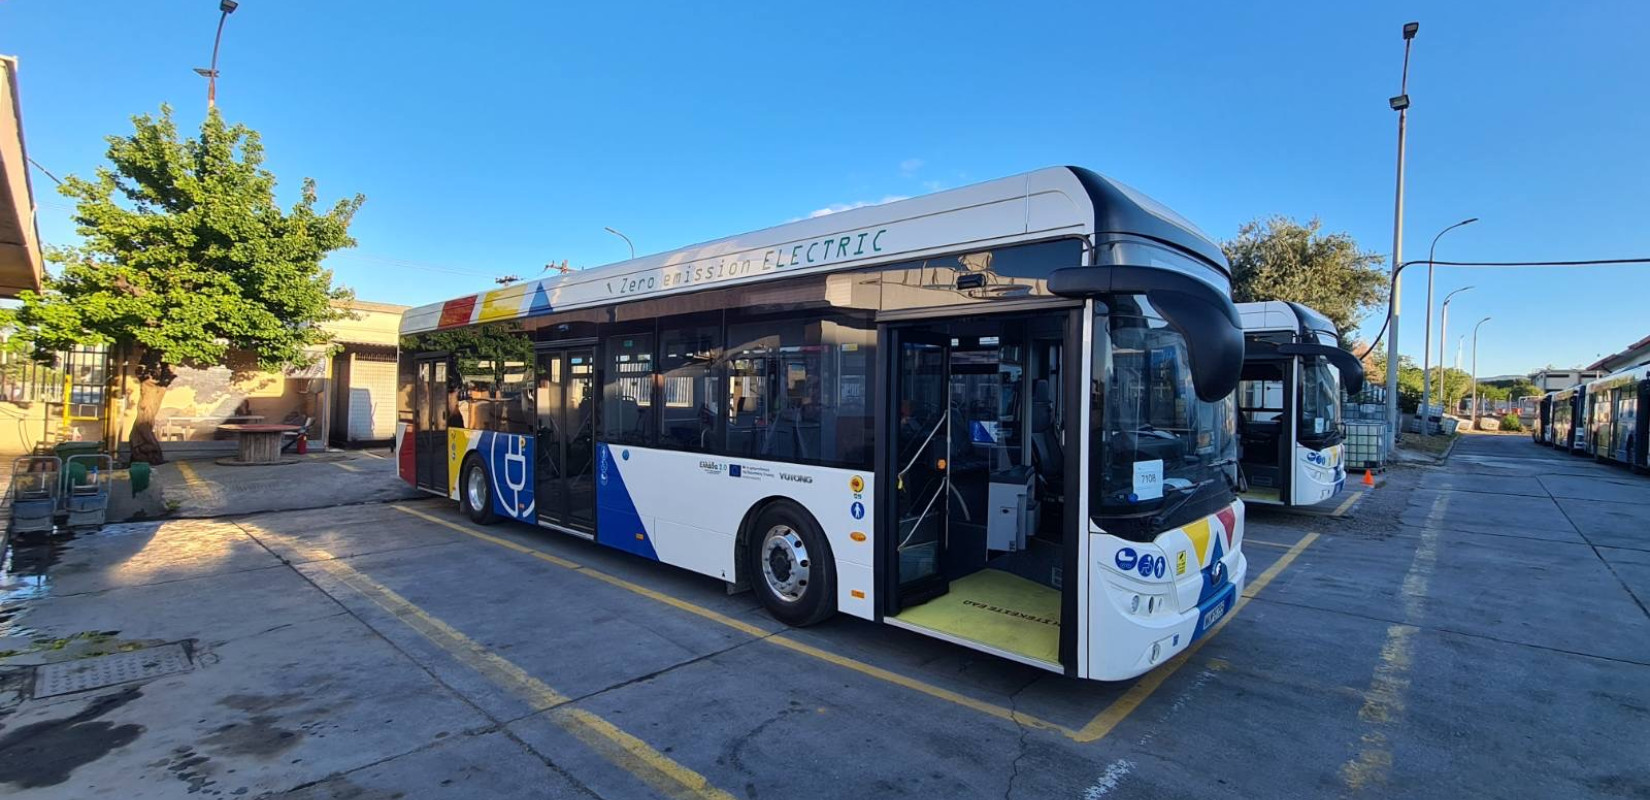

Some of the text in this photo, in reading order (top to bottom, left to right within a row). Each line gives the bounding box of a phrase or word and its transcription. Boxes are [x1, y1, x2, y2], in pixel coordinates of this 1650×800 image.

[620, 229, 887, 294] Zero emission ELECTRIC
